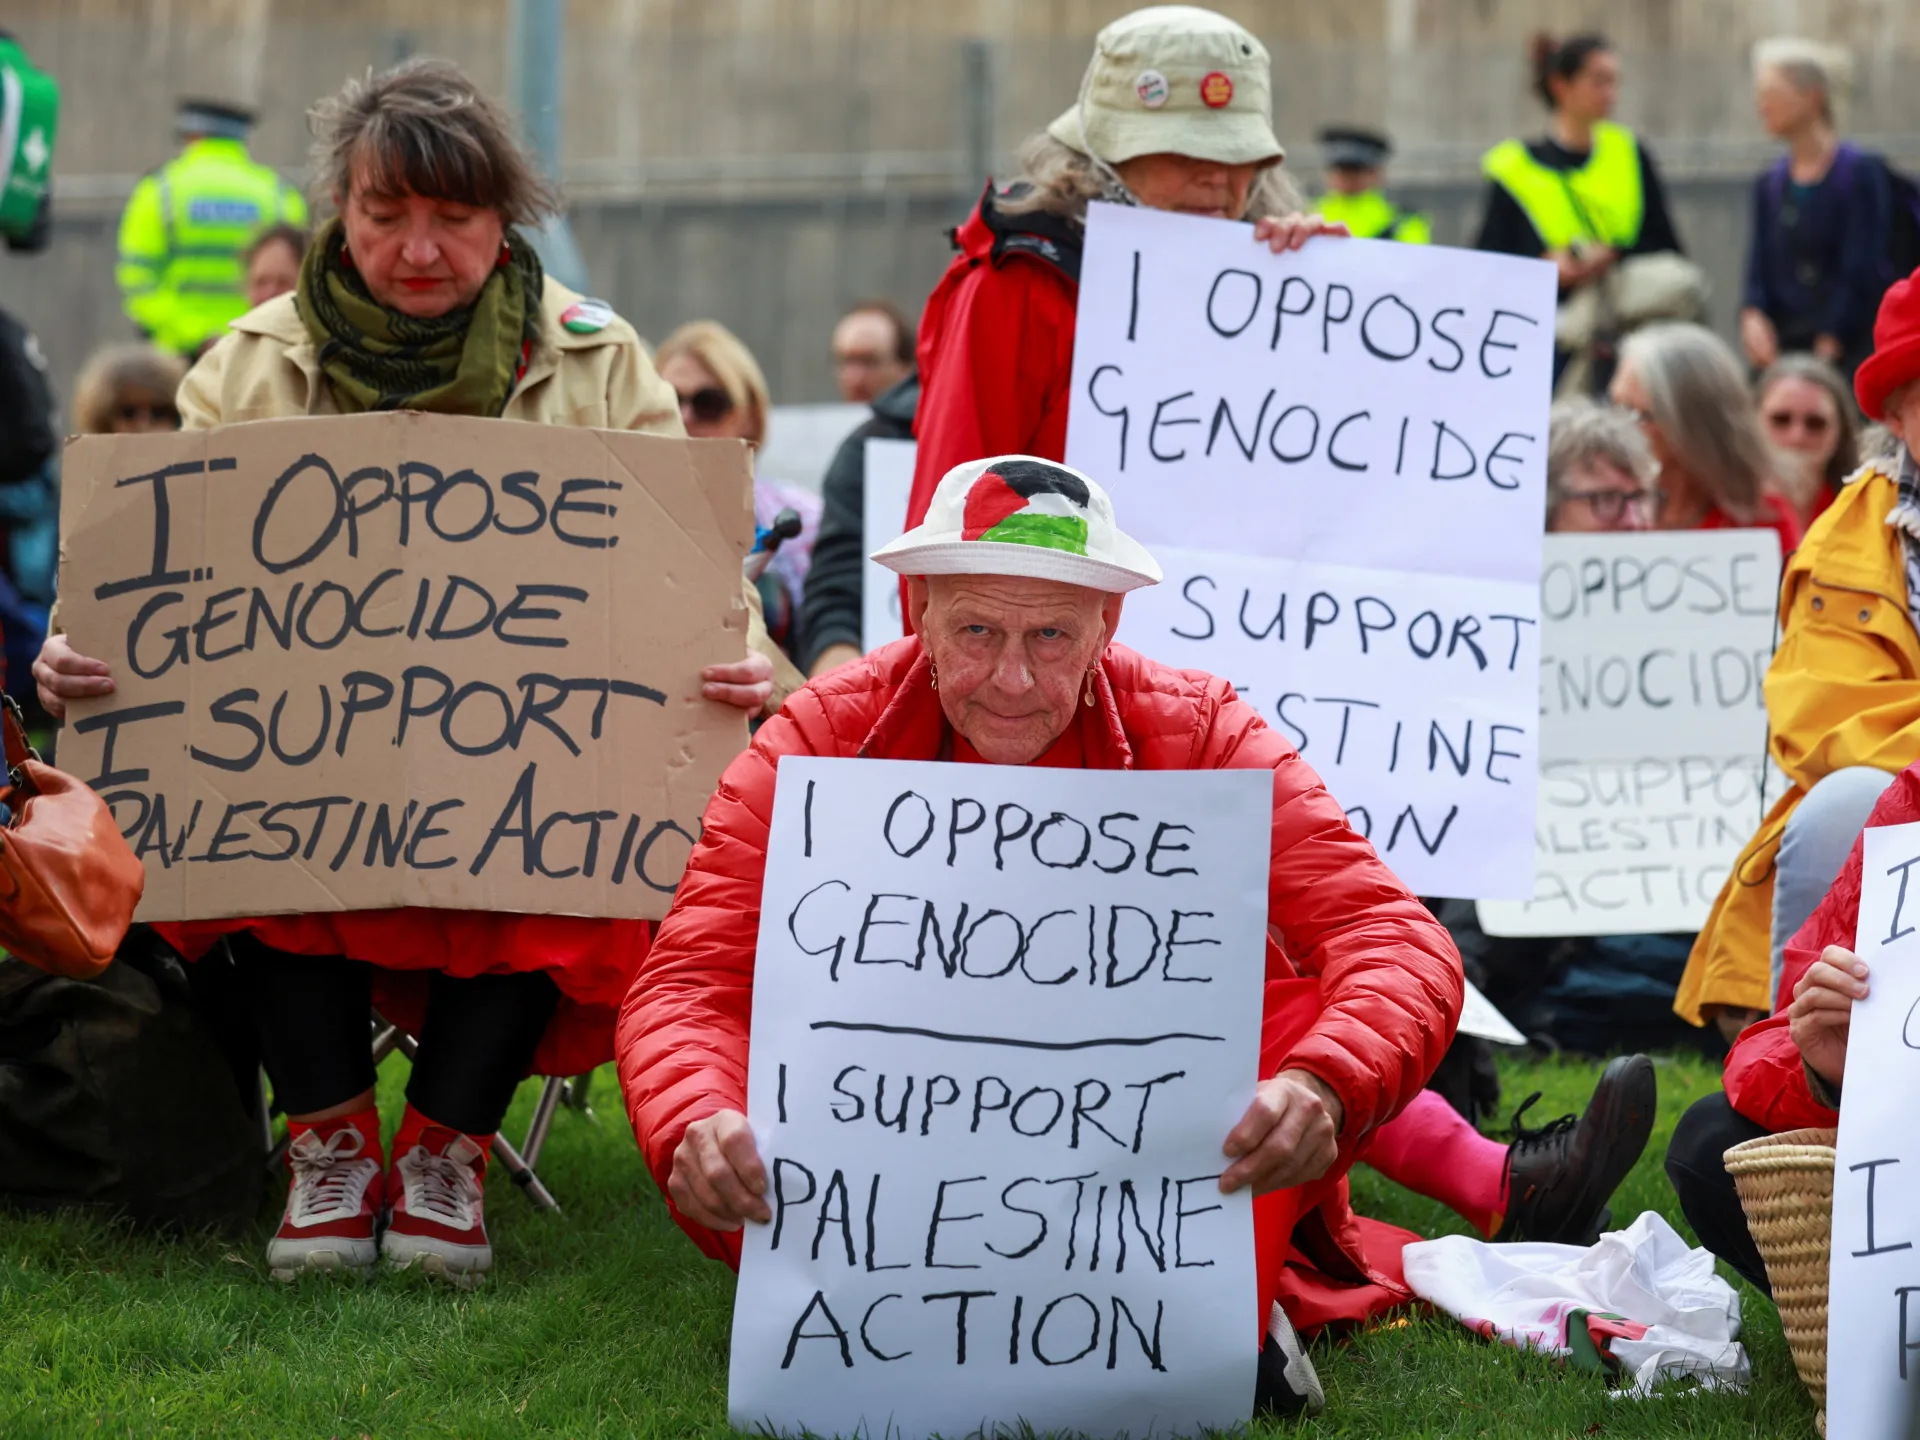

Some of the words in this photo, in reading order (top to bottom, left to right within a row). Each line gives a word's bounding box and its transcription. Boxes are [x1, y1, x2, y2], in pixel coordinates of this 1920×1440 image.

[1127, 250, 1140, 342] I
[1205, 268, 1539, 378] OPPOSE
[1088, 364, 1536, 490] GENOCIDE
[95, 456, 237, 600] I
[126, 568, 589, 680] GENOCIDE
[1170, 575, 1536, 671] SUPPORT
[1541, 552, 1774, 622] OPPOSE
[74, 701, 184, 792] I
[190, 666, 666, 772] SUPPORT
[1235, 685, 1526, 784] STINE
[468, 762, 704, 893] ACTIO
[804, 779, 816, 858] I
[882, 788, 1200, 878] OPPOSE
[786, 878, 1223, 990] GENOCIDE
[777, 1063, 787, 1123] I
[828, 1064, 1187, 1155] SUPPORT
[769, 1155, 1224, 1274] PALESTINE
[1848, 1157, 1913, 1258] I
[779, 1288, 1170, 1374] ACTION
